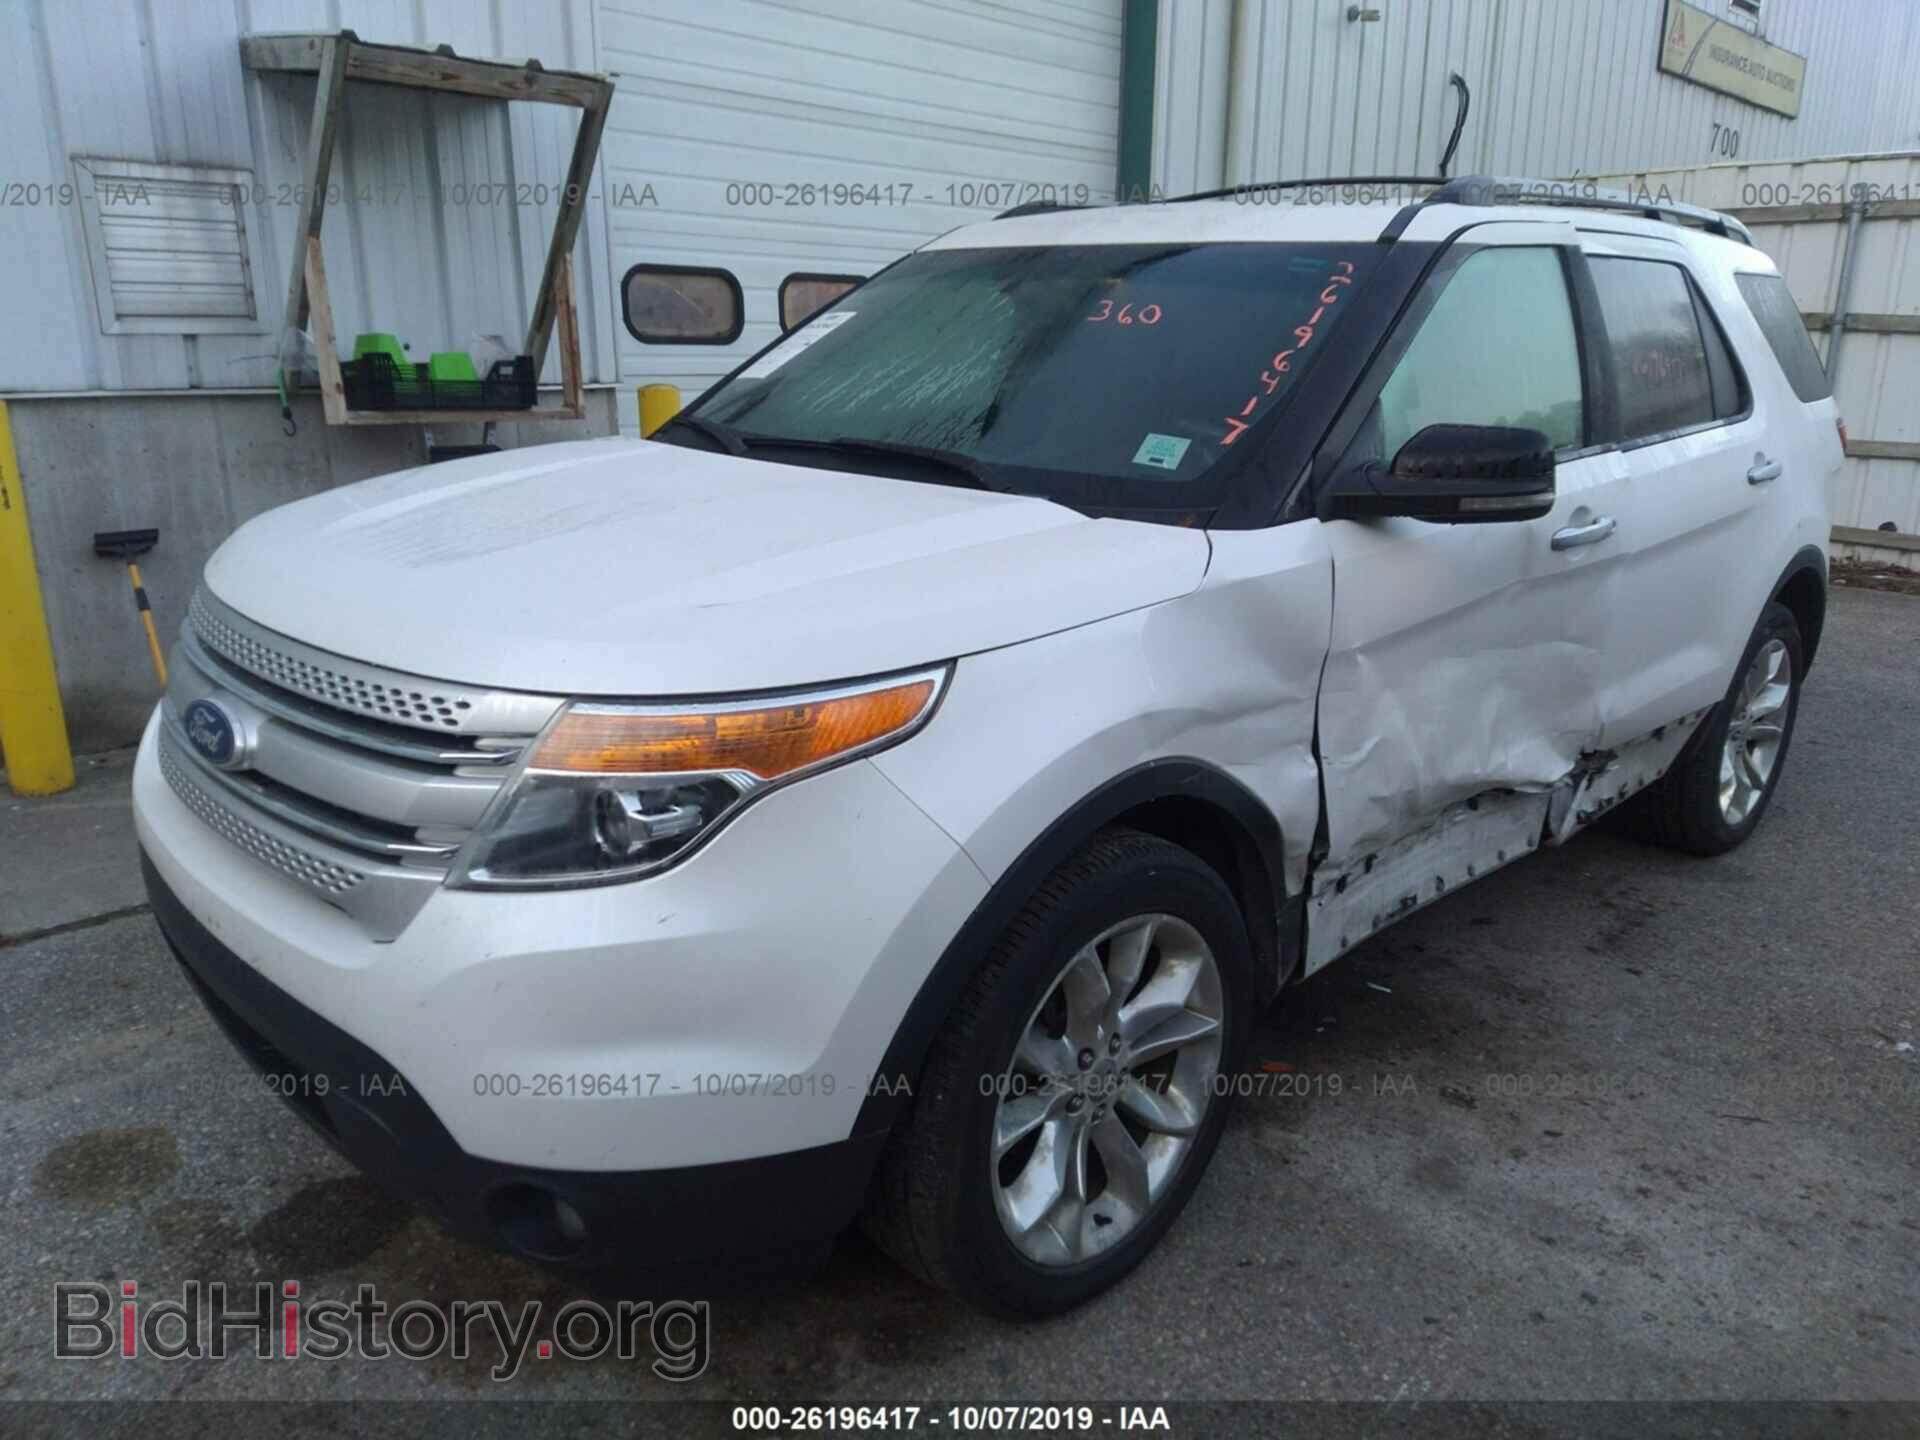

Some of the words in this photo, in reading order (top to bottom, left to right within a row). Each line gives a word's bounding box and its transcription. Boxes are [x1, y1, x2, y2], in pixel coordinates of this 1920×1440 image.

[1710, 122, 1738, 159] 700
[1087, 299, 1163, 326] 360
[190, 706, 224, 754] Ford
